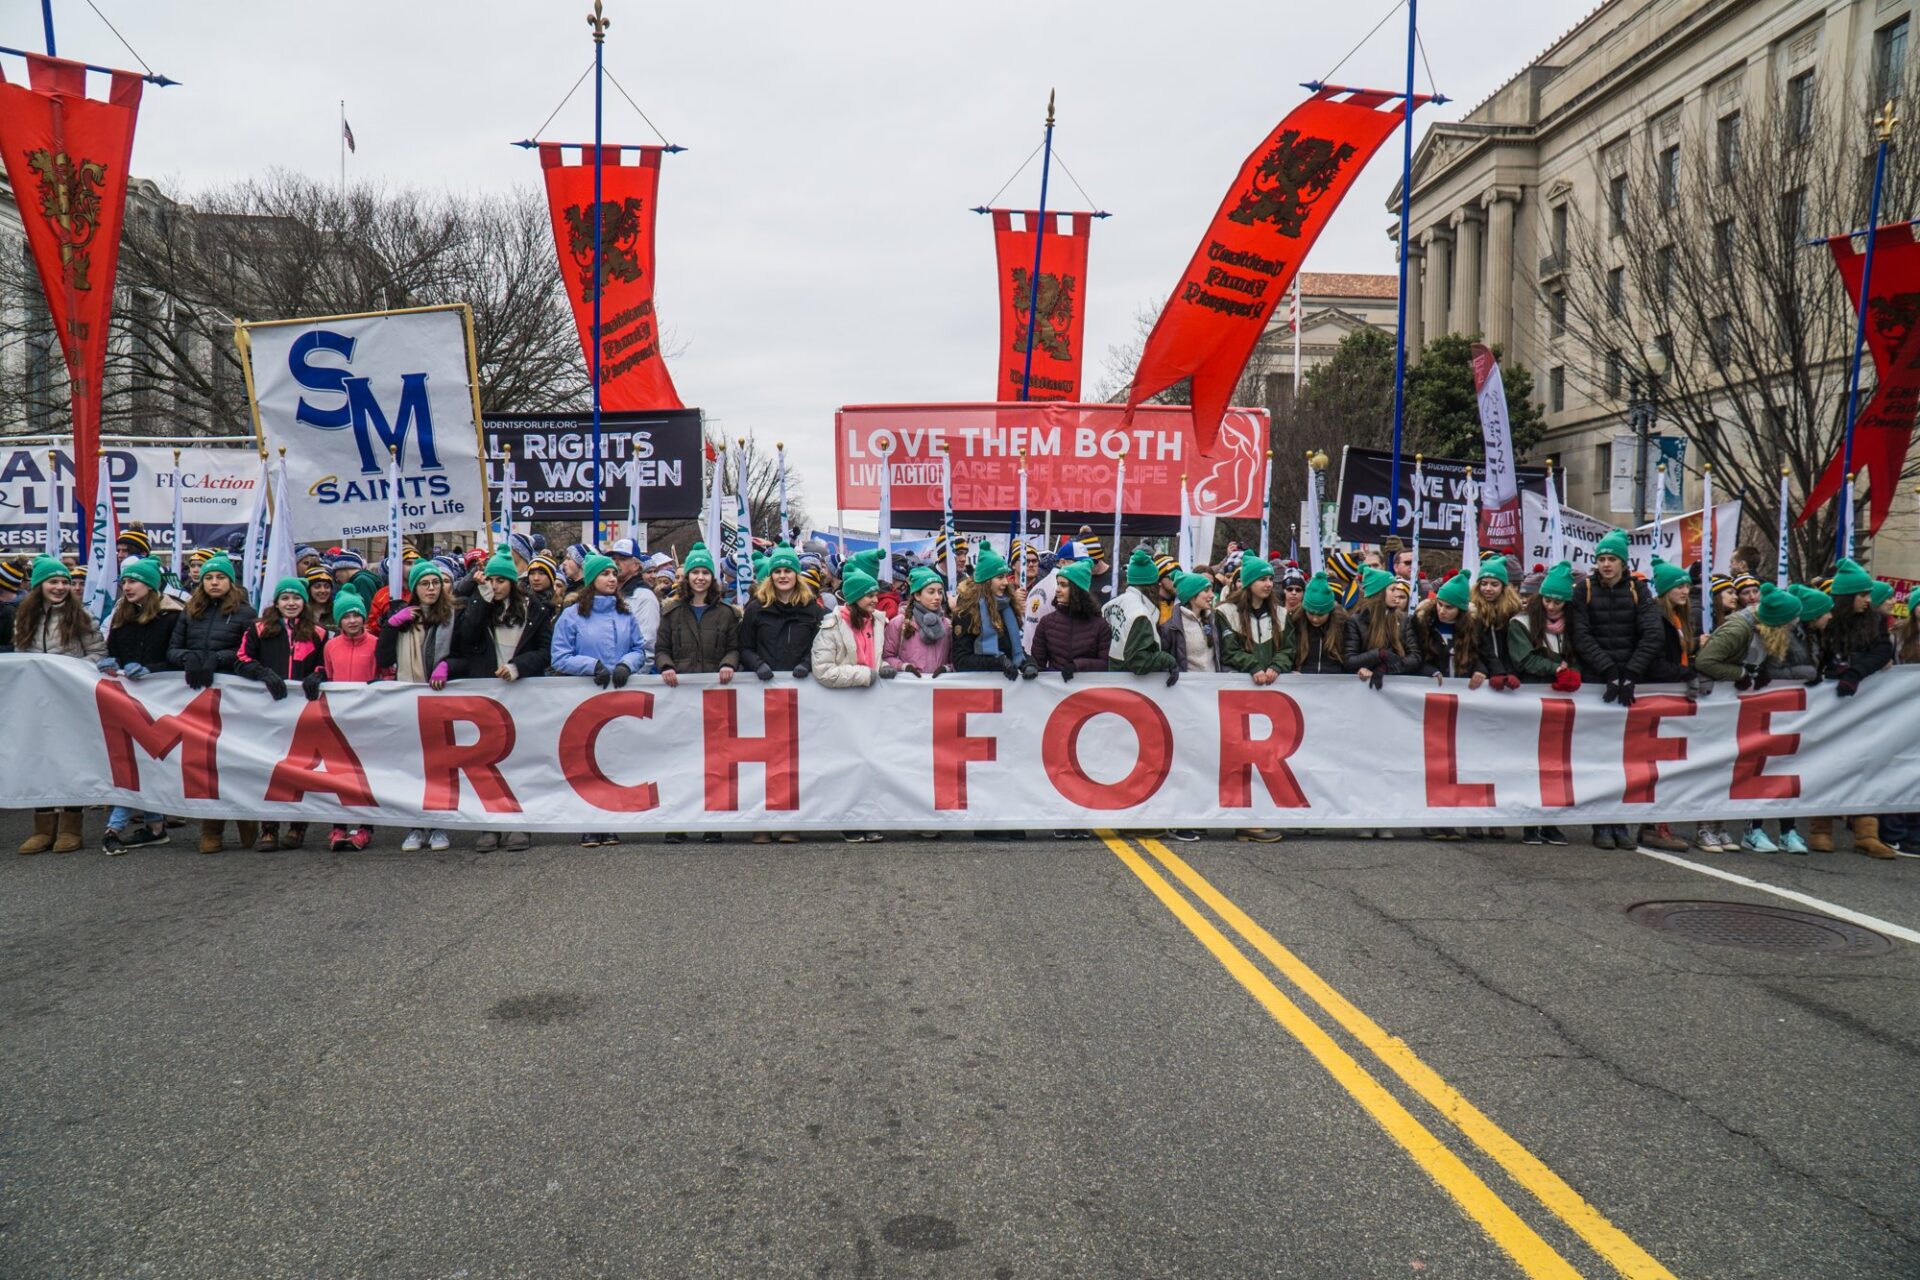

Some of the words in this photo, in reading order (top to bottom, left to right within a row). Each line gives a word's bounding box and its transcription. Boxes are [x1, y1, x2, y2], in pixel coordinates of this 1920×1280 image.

[523, 432, 654, 460] RIGHTS
[848, 428, 946, 458] LOVE
[960, 427, 1061, 457] THEM
[1075, 427, 1183, 461] BOTH
[539, 460, 682, 488] WOMEN
[1410, 474, 1443, 498] WE
[401, 501, 426, 516] for
[432, 499, 465, 515] Life
[410, 521, 426, 530] ND
[95, 678, 799, 813] MARCH
[932, 687, 1311, 811] FOR
[1424, 687, 1808, 808] LIFE
